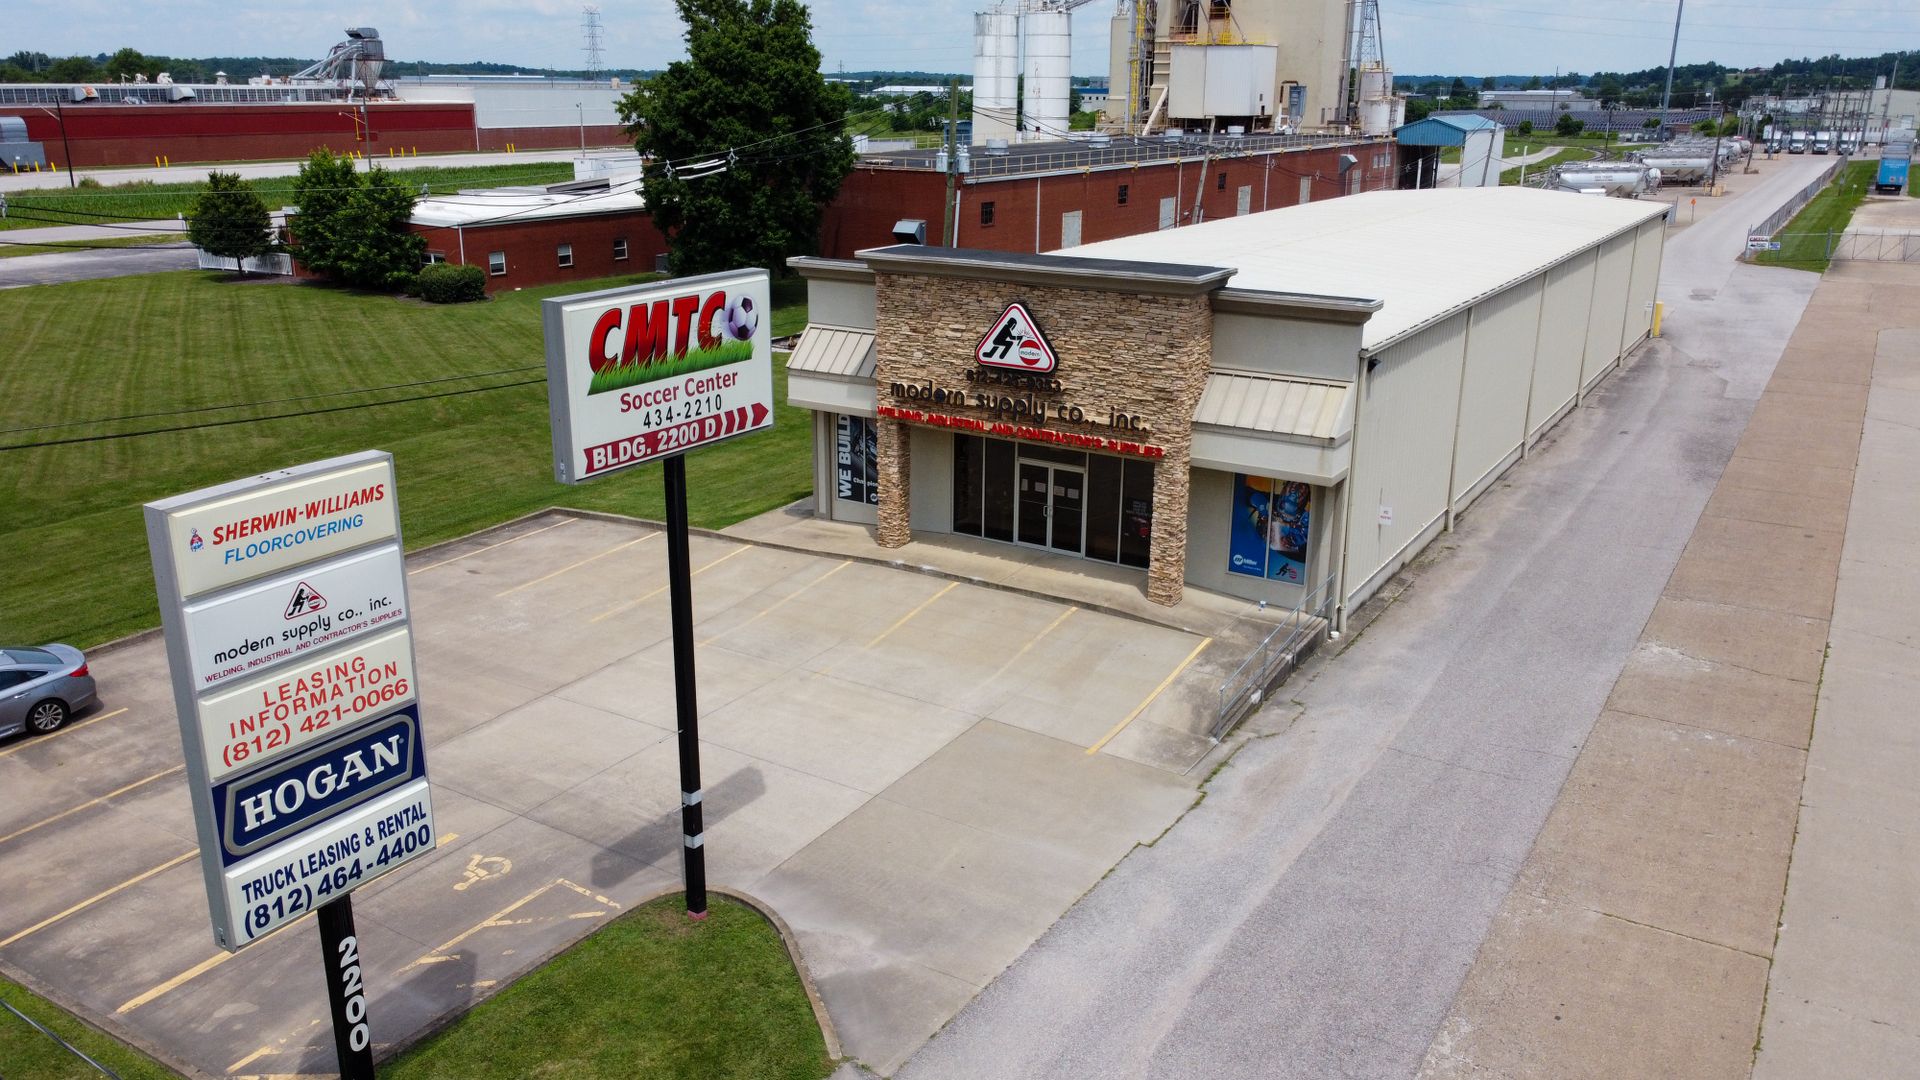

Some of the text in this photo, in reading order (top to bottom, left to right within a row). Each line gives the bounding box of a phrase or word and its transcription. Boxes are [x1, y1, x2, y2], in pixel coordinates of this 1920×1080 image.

[588, 291, 726, 374] CMTC
[620, 370, 738, 413] Soccer Center
[643, 394, 722, 429] 434-2210
[891, 380, 1147, 432] modern supply co., inc.
[592, 418, 716, 470] BLDG. 2200 D
[838, 415, 852, 498] WE BUILD
[991, 423, 1014, 435] AND
[1107, 439, 1164, 457] SUPPLIES
[212, 484, 385, 545] SHERWIN-WILLIAMS
[224, 514, 364, 564] FLOORCOVERING
[205, 608, 403, 683] WELDING, INDUSTRIAL AND CONTRACTOR'S SUPPLIES
[213, 595, 392, 665] modern supply co., inc.
[229, 661, 399, 740] INFORMATION
[263, 656, 367, 708] LEASING
[222, 678, 409, 768] (812) 421-0066
[240, 734, 401, 833] HOGAN
[241, 801, 427, 905] TRUCK LEASING & RENTAL
[244, 883, 313, 939] (812)
[338, 935, 370, 1052] 2200
